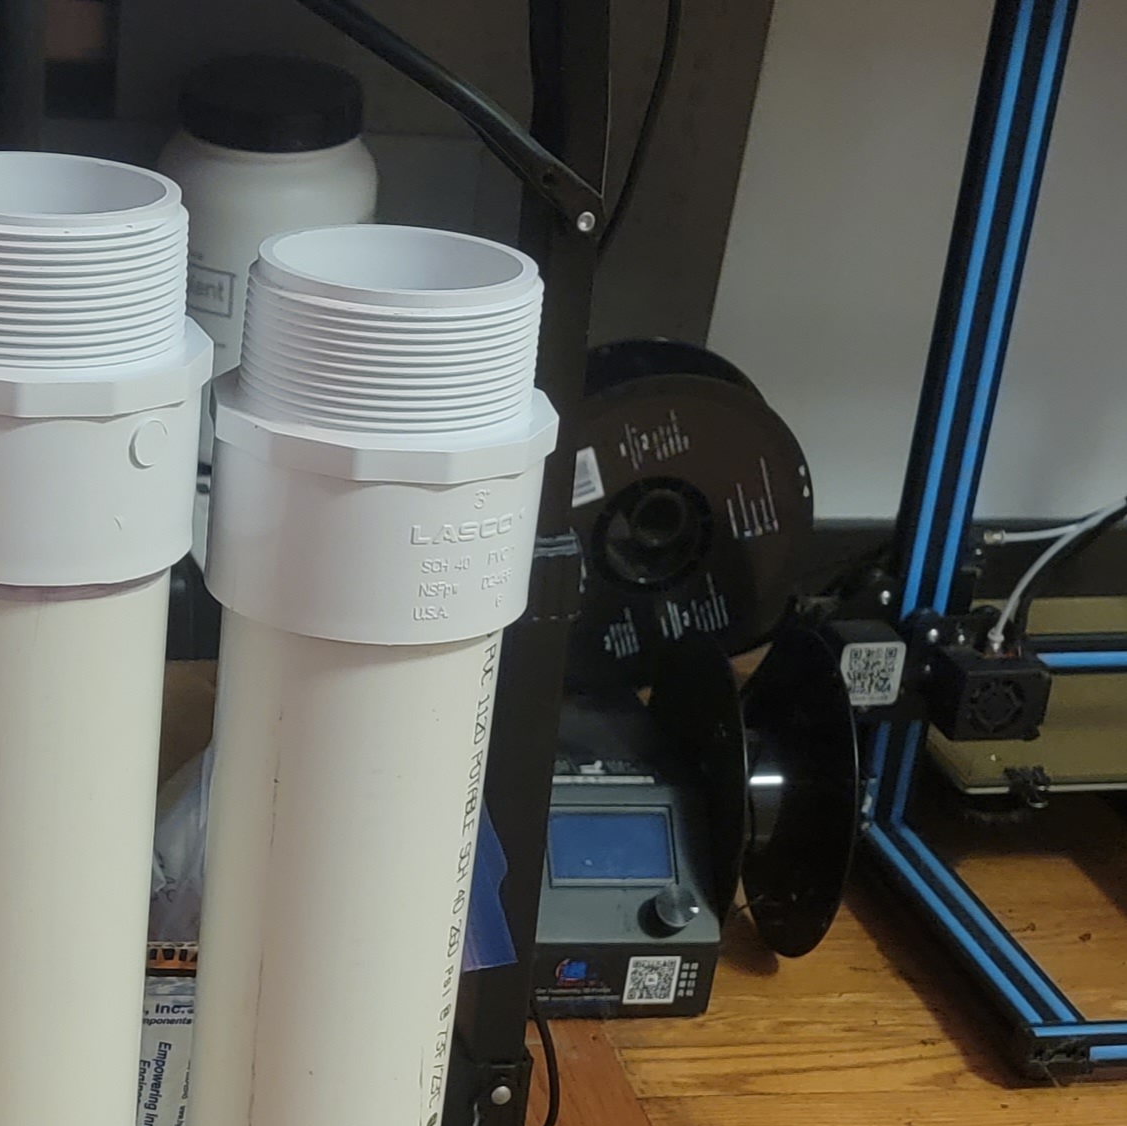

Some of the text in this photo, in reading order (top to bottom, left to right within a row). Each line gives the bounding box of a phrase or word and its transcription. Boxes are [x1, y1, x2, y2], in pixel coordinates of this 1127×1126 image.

[410, 513, 513, 545] LASCO
[421, 559, 448, 574] SCH
[481, 643, 497, 686] PVC
[474, 694, 490, 745] 1120
[462, 749, 484, 836] POTABLE
[457, 841, 472, 882] SCH
[453, 889, 465, 914] 40
[448, 919, 462, 957] 260
[144, 1041, 172, 1110] Empowering
